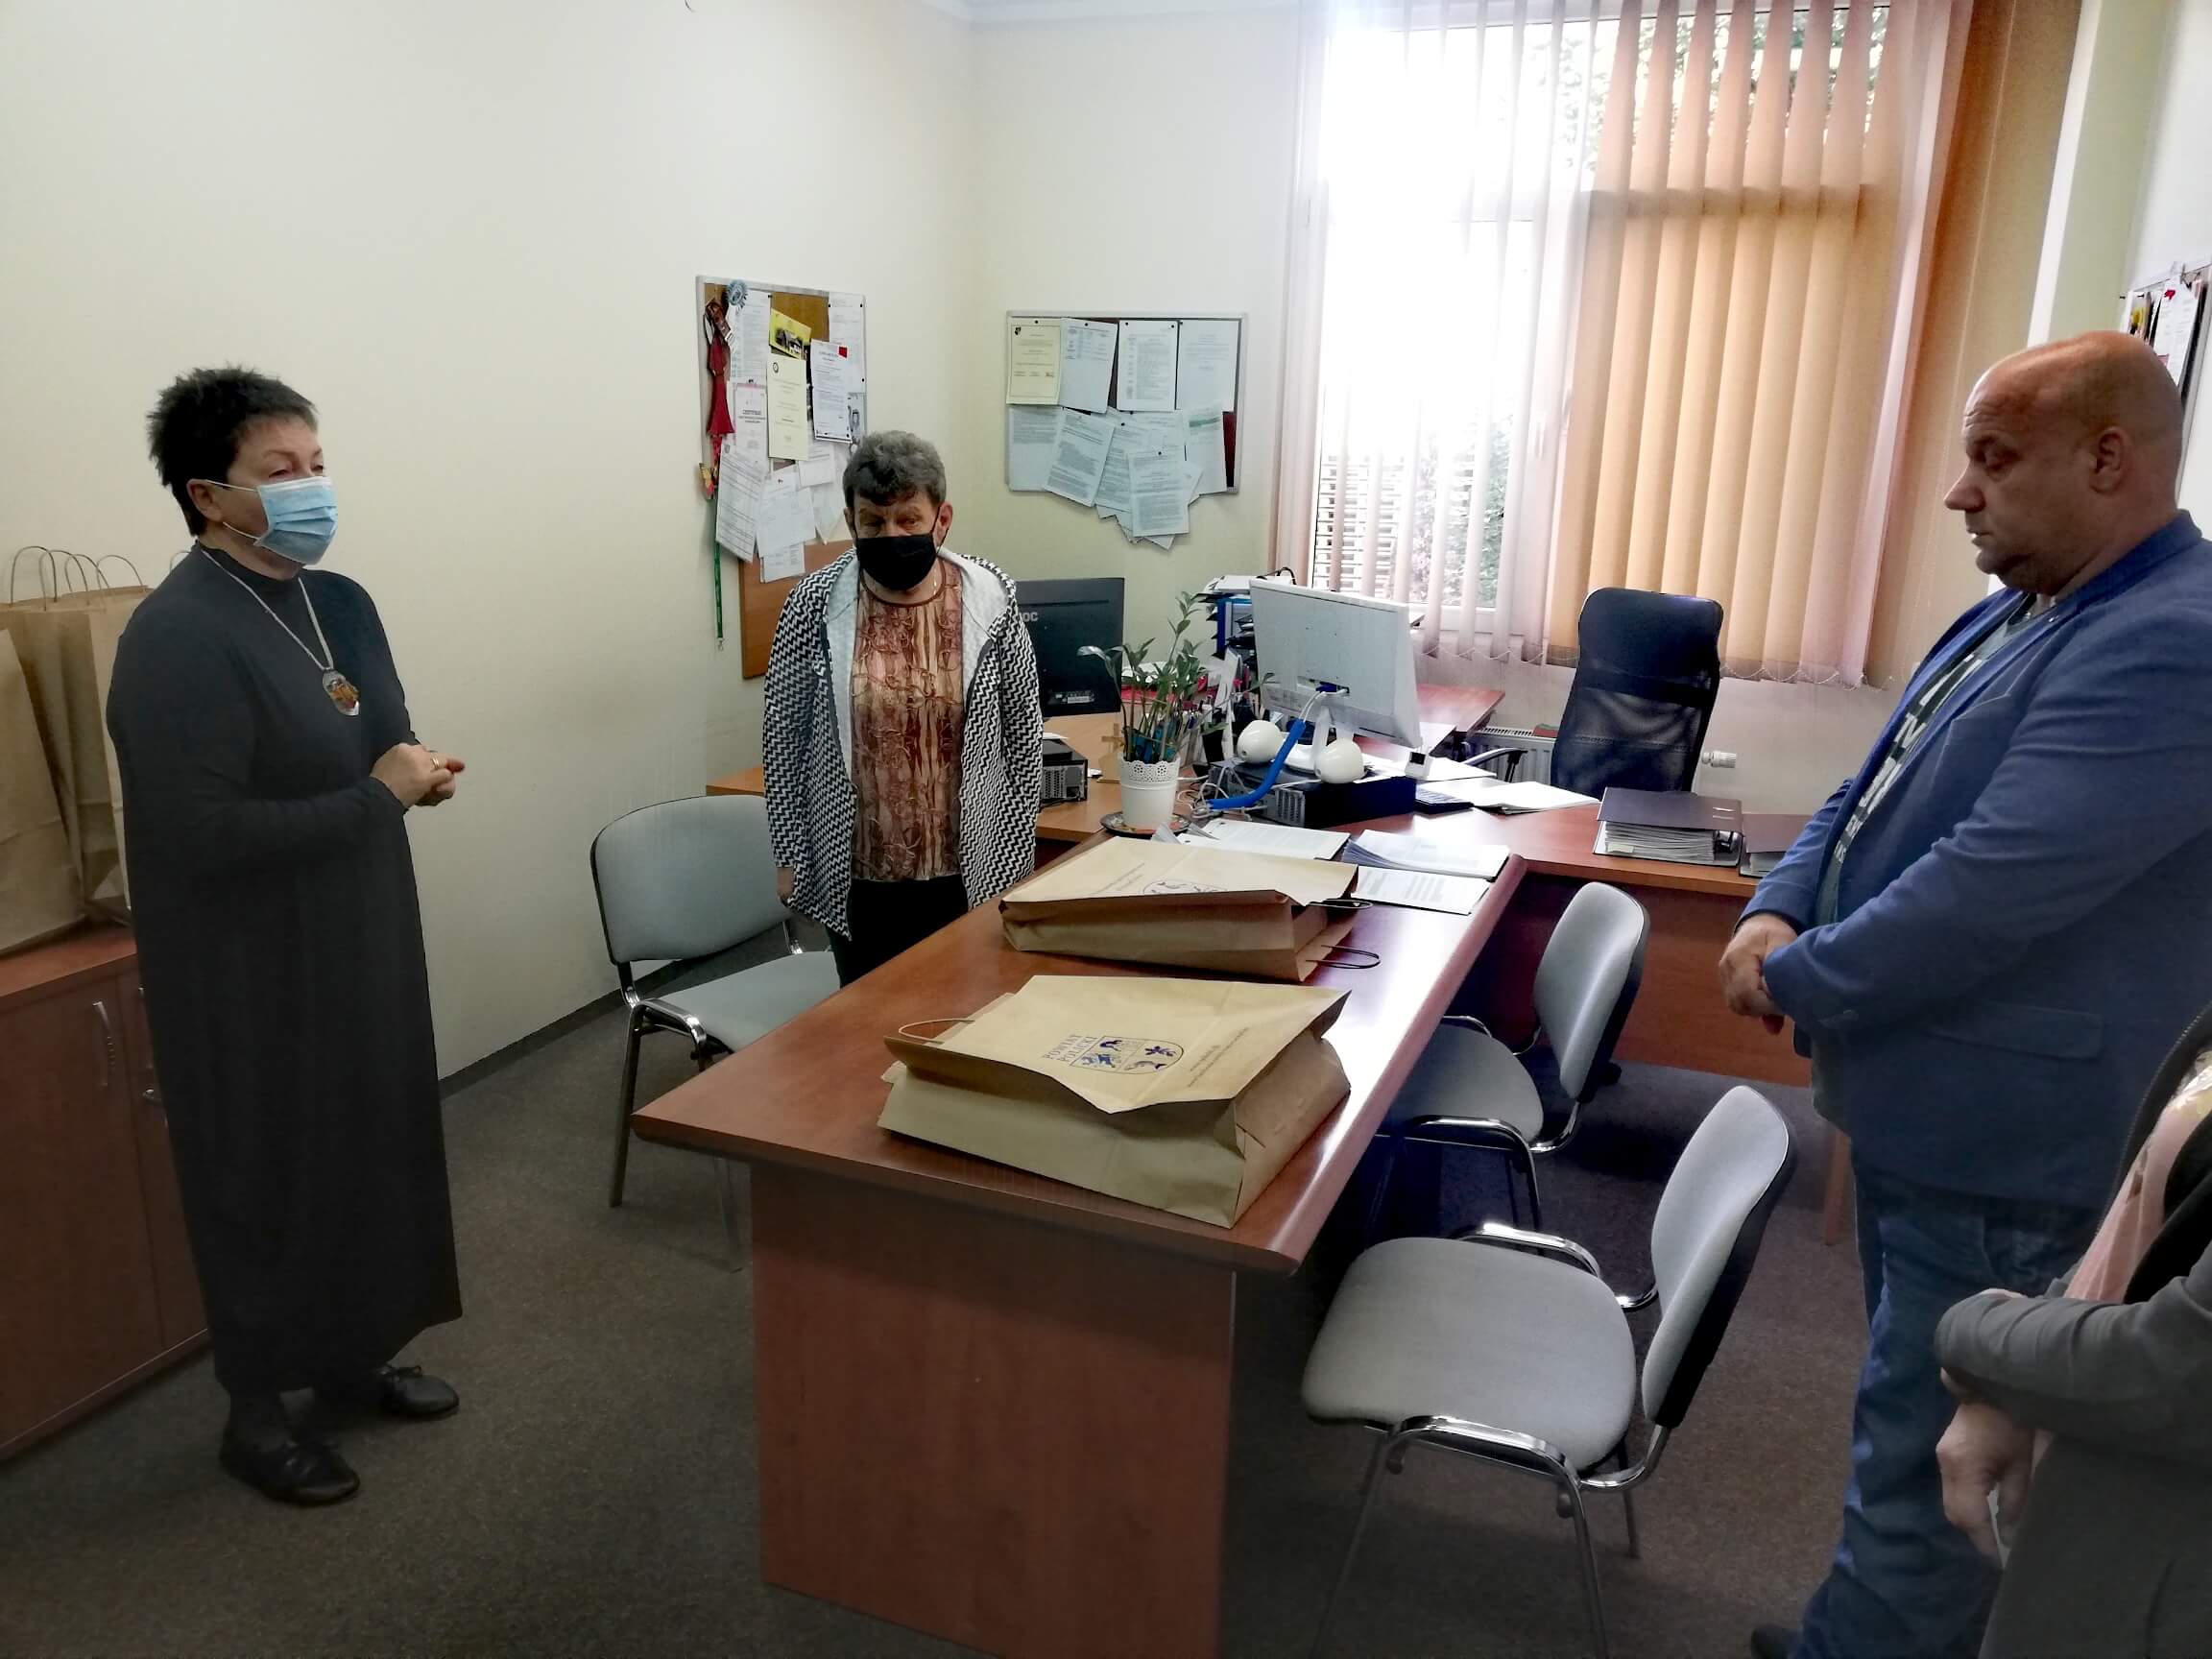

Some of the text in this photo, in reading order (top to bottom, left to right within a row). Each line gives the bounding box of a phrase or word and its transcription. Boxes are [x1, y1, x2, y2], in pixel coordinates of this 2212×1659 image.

[1019, 612, 1039, 622] OC
[1042, 1035, 1083, 1060] POWIAT
[1060, 1036, 1097, 1062] POLICKI
